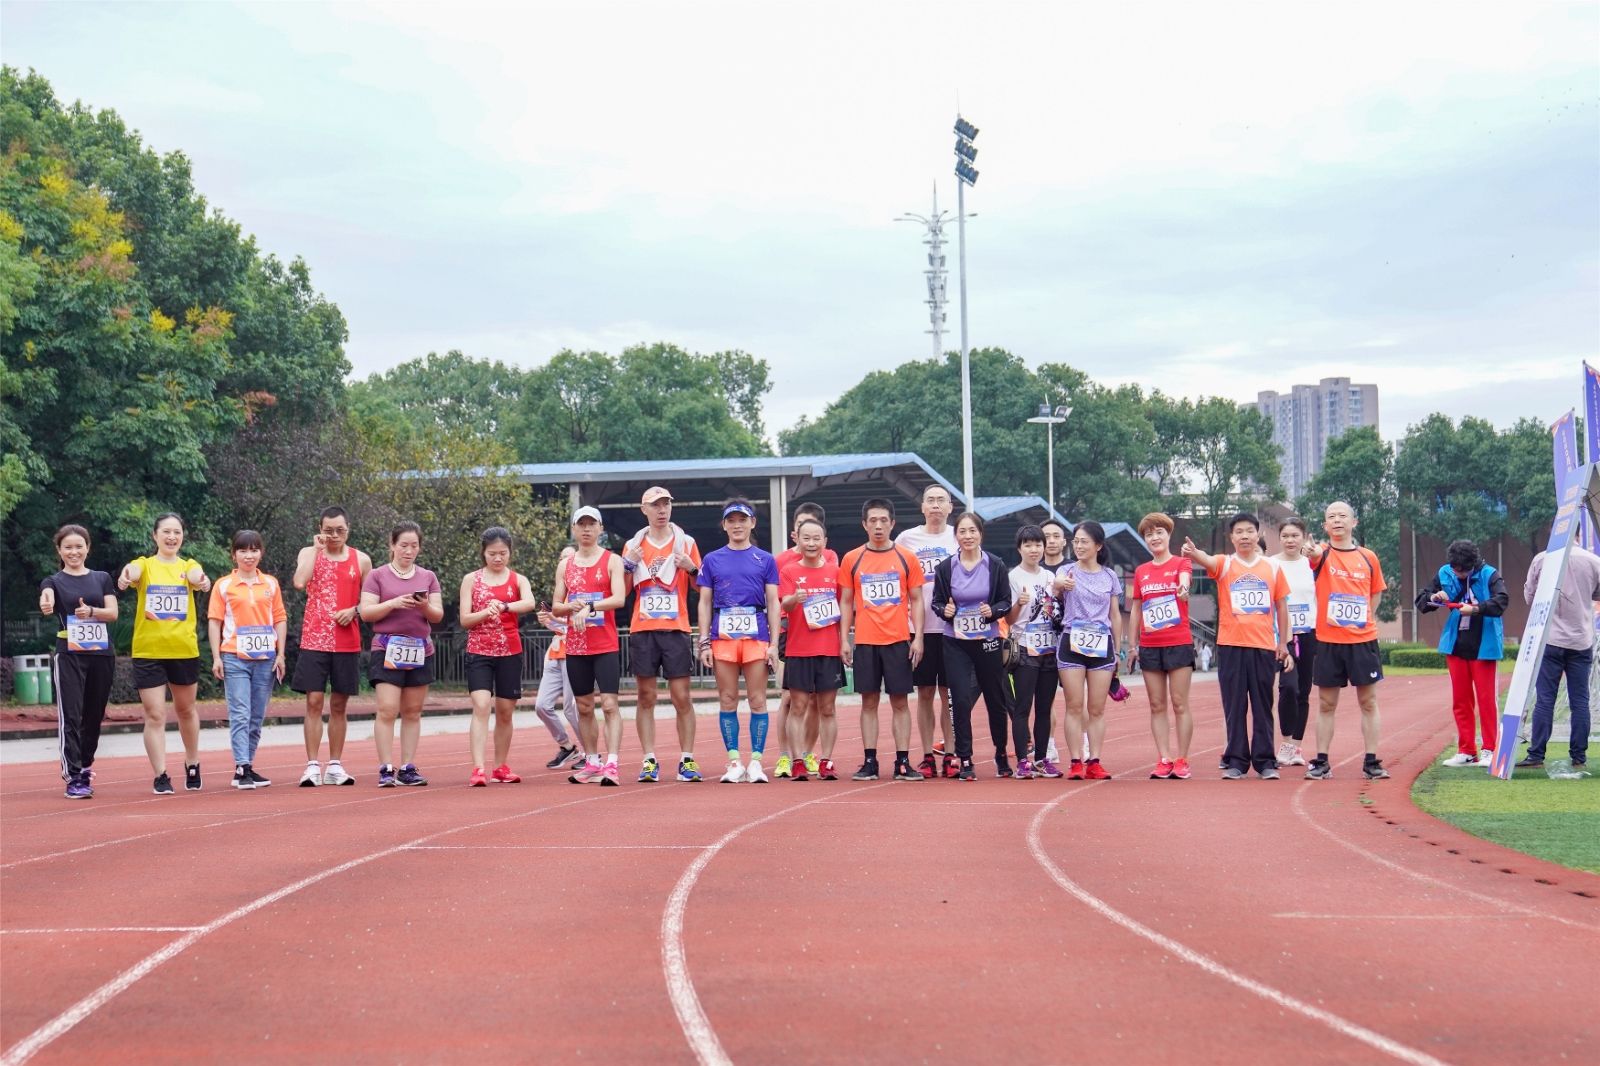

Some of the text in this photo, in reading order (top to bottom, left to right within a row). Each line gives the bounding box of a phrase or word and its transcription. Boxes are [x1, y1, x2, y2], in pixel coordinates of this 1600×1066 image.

[870, 583, 894, 598] 310
[155, 596, 181, 611] 301
[647, 596, 672, 611] 323
[1240, 592, 1264, 606] 302
[812, 601, 833, 620] 307
[1148, 604, 1173, 624] 306
[1336, 603, 1361, 620] 309
[727, 616, 751, 631] 329
[962, 616, 986, 631] 318
[1292, 613, 1306, 627] 19
[78, 625, 103, 640] 330
[246, 635, 270, 651] 304
[1077, 632, 1103, 649] 327
[393, 647, 419, 663] 311
